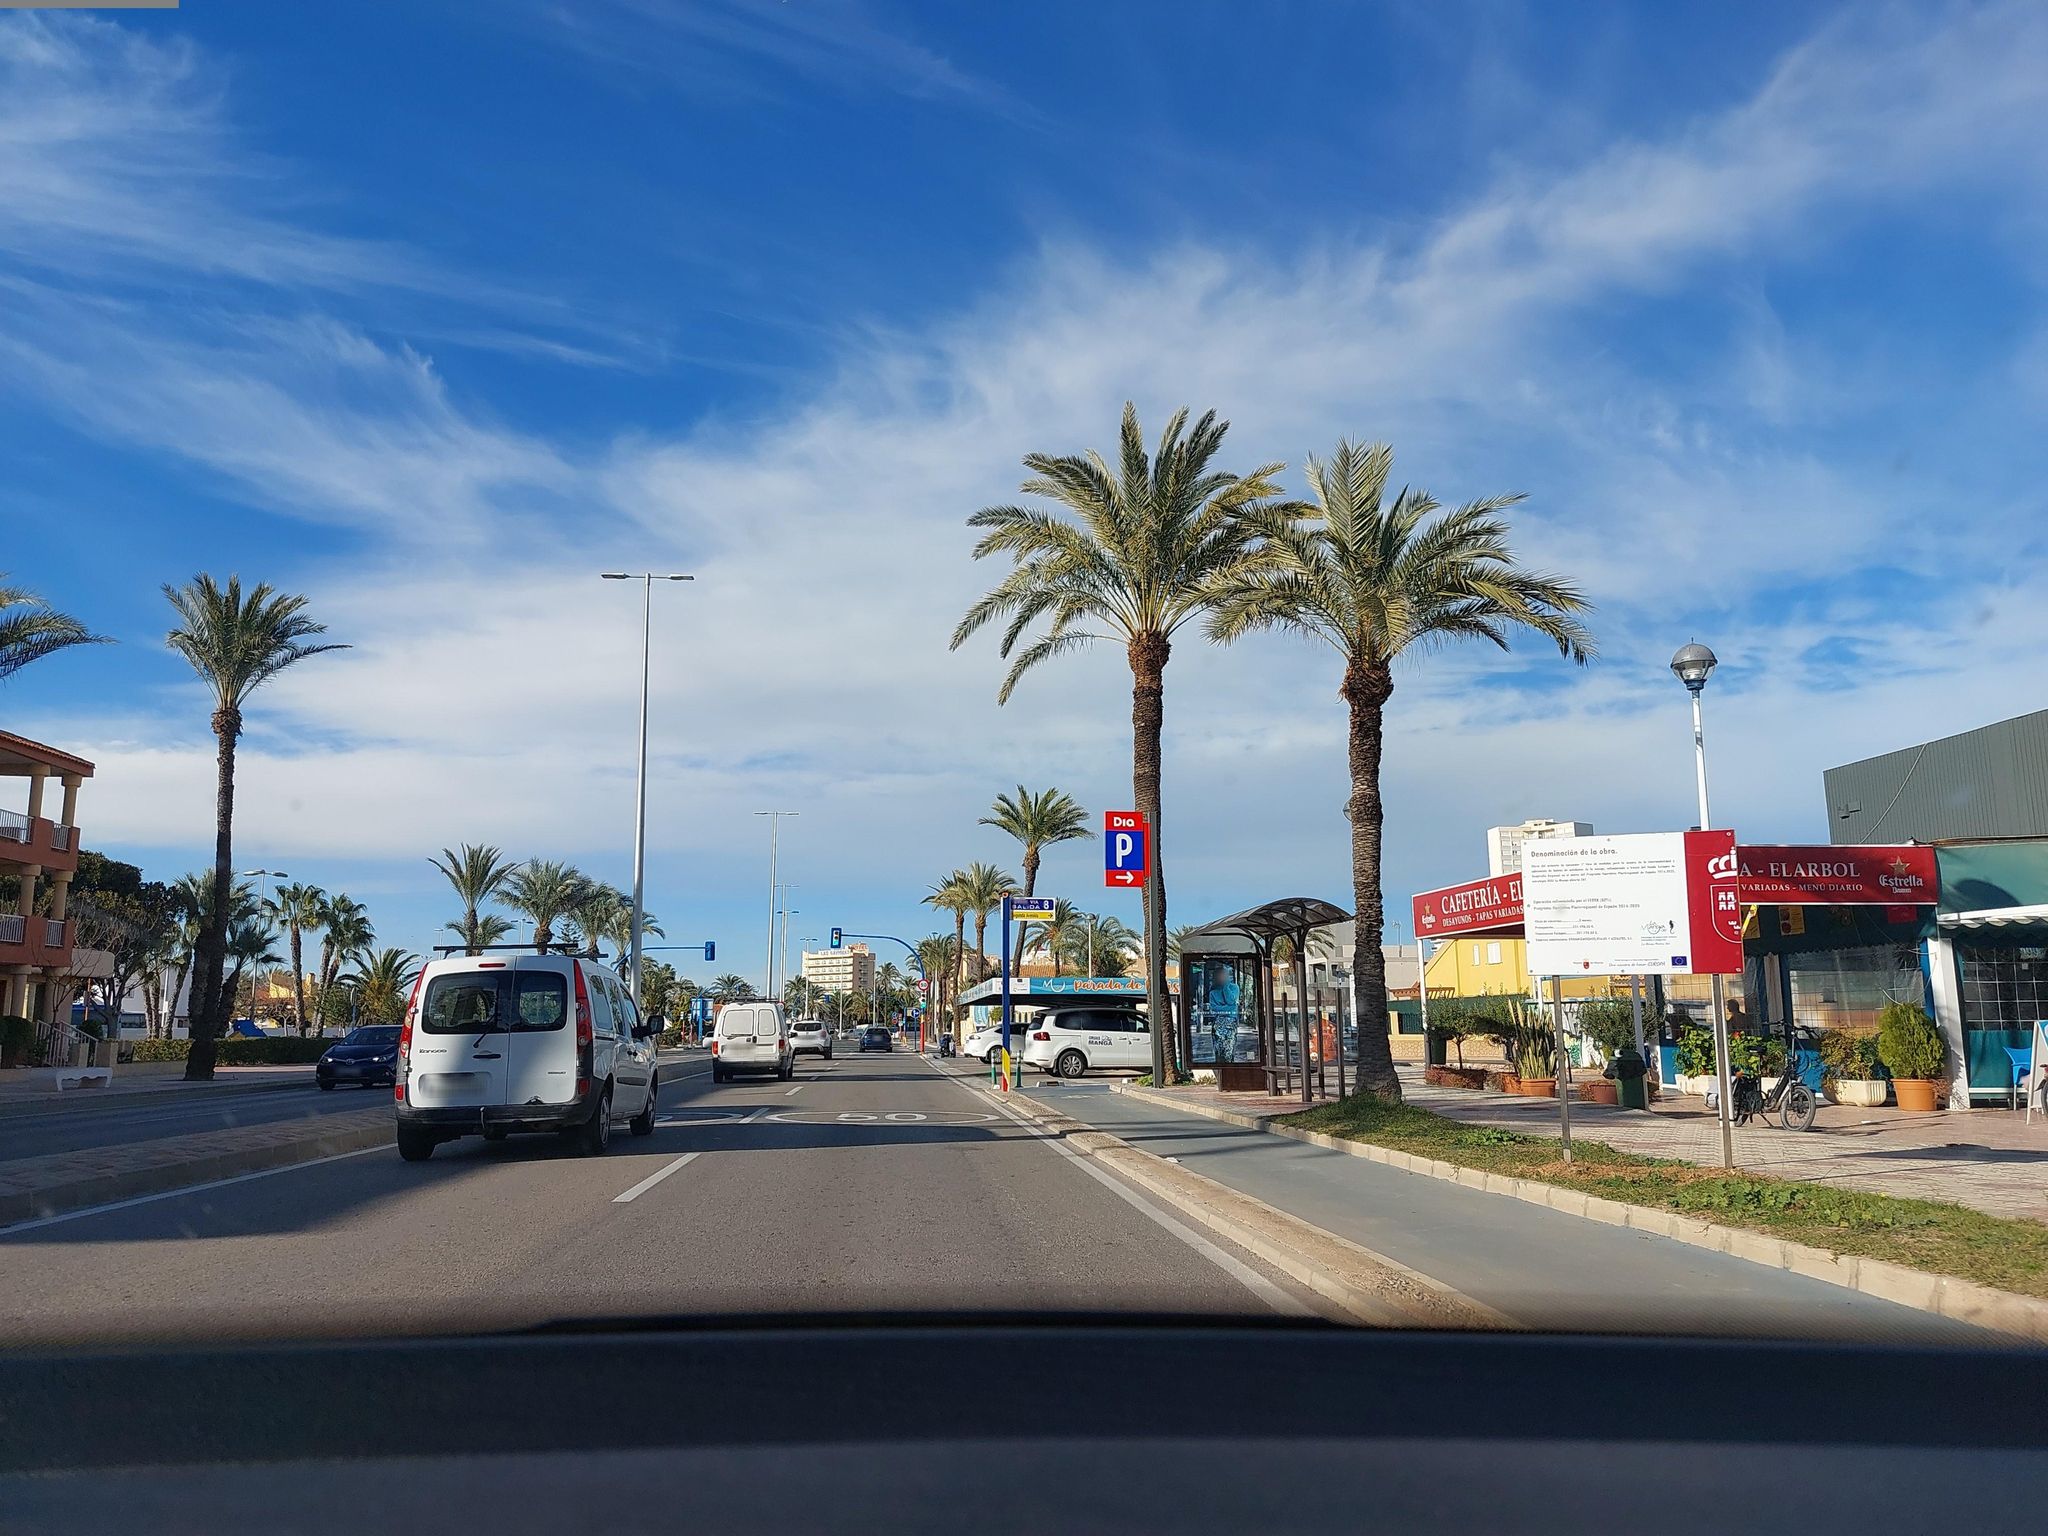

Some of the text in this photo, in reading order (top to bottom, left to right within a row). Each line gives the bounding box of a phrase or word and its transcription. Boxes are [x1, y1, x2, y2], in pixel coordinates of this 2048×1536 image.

[1115, 833, 1133, 868] P
[1531, 849, 1578, 858] Denominación
[1769, 862, 1861, 878] ELARBOL
[1741, 883, 1791, 891] VARIADAS
[1798, 882, 1826, 891] MENÚ
[1828, 884, 1863, 892] DIARIO
[1879, 874, 1924, 887] Estrella
[1043, 899, 1050, 910] 8
[1441, 881, 1501, 915] CAFETERÍA
[1442, 914, 1472, 927] DESAYUNOS
[1475, 910, 1493, 922] TAPAS
[1493, 904, 1524, 918] VARIADAS
[1073, 978, 1118, 993] parada
[1124, 978, 1142, 991] de
[835, 1113, 928, 1122] 50
